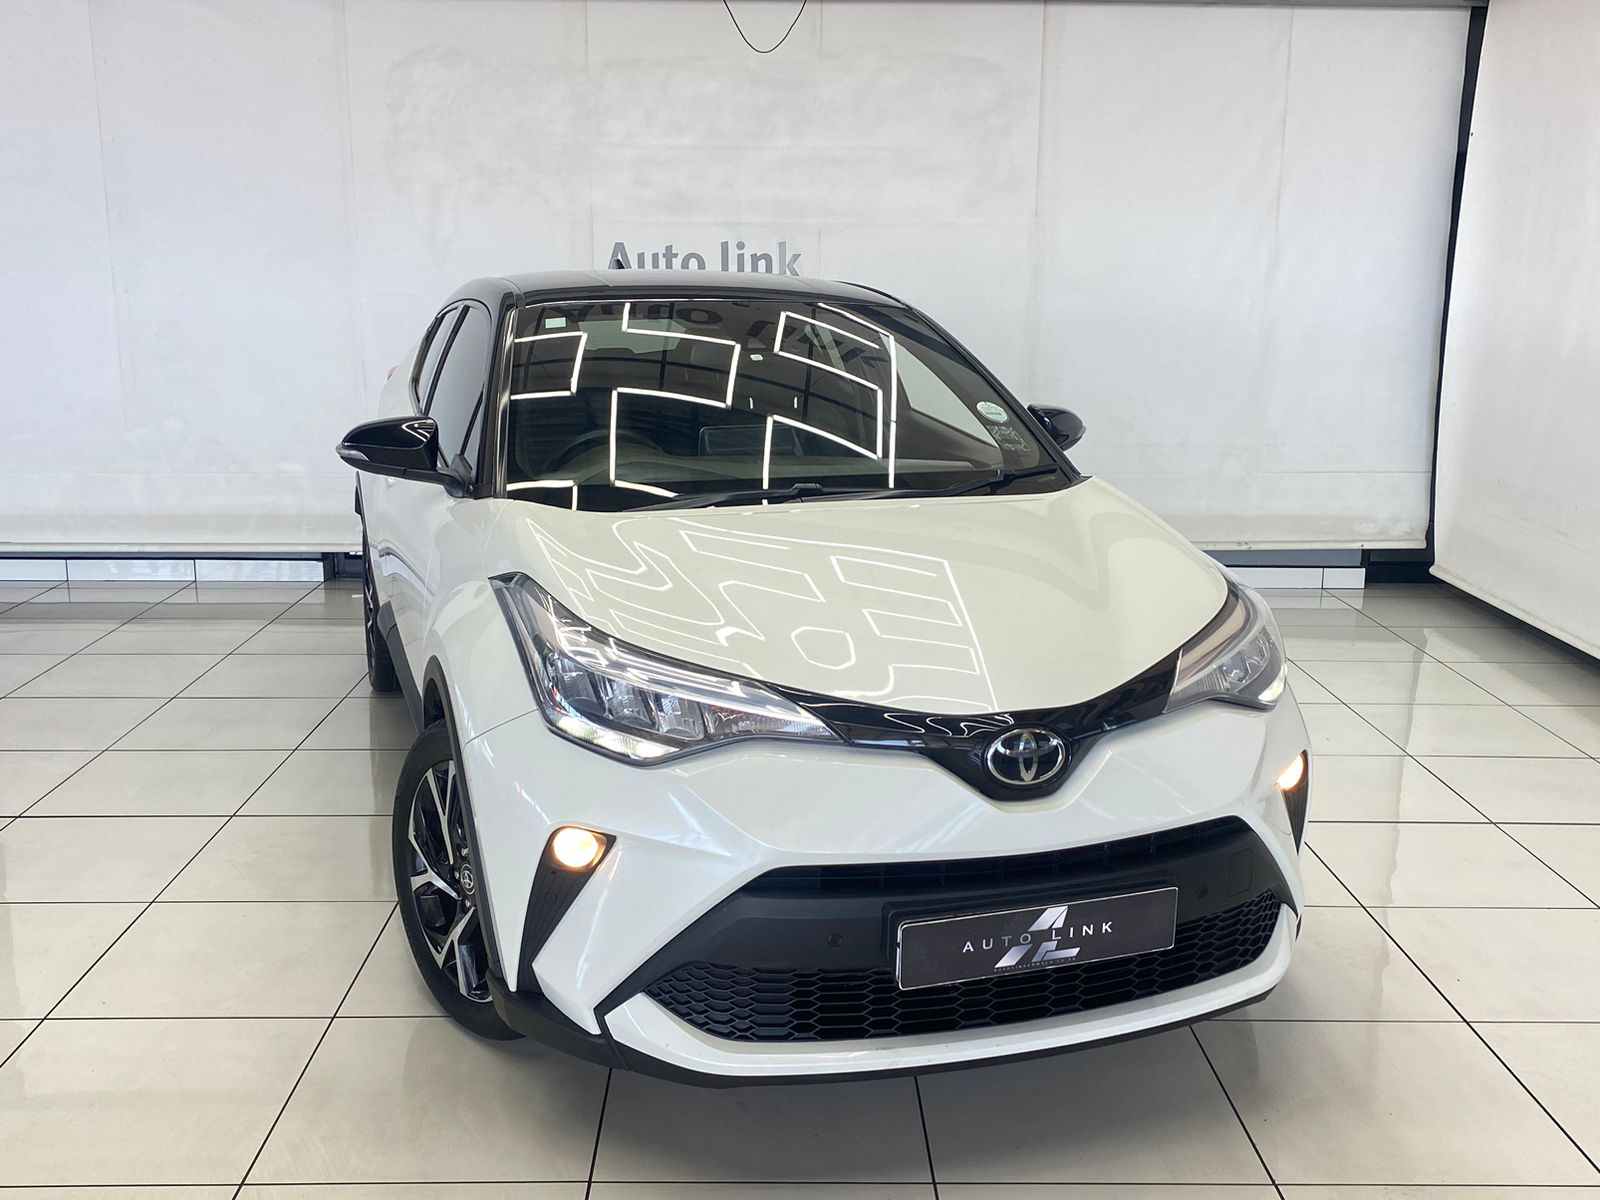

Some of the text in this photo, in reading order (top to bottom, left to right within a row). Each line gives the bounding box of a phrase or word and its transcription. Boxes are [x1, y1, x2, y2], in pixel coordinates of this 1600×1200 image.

[608, 241, 802, 276] Auto link
[962, 921, 1113, 953] AUTO LINK
